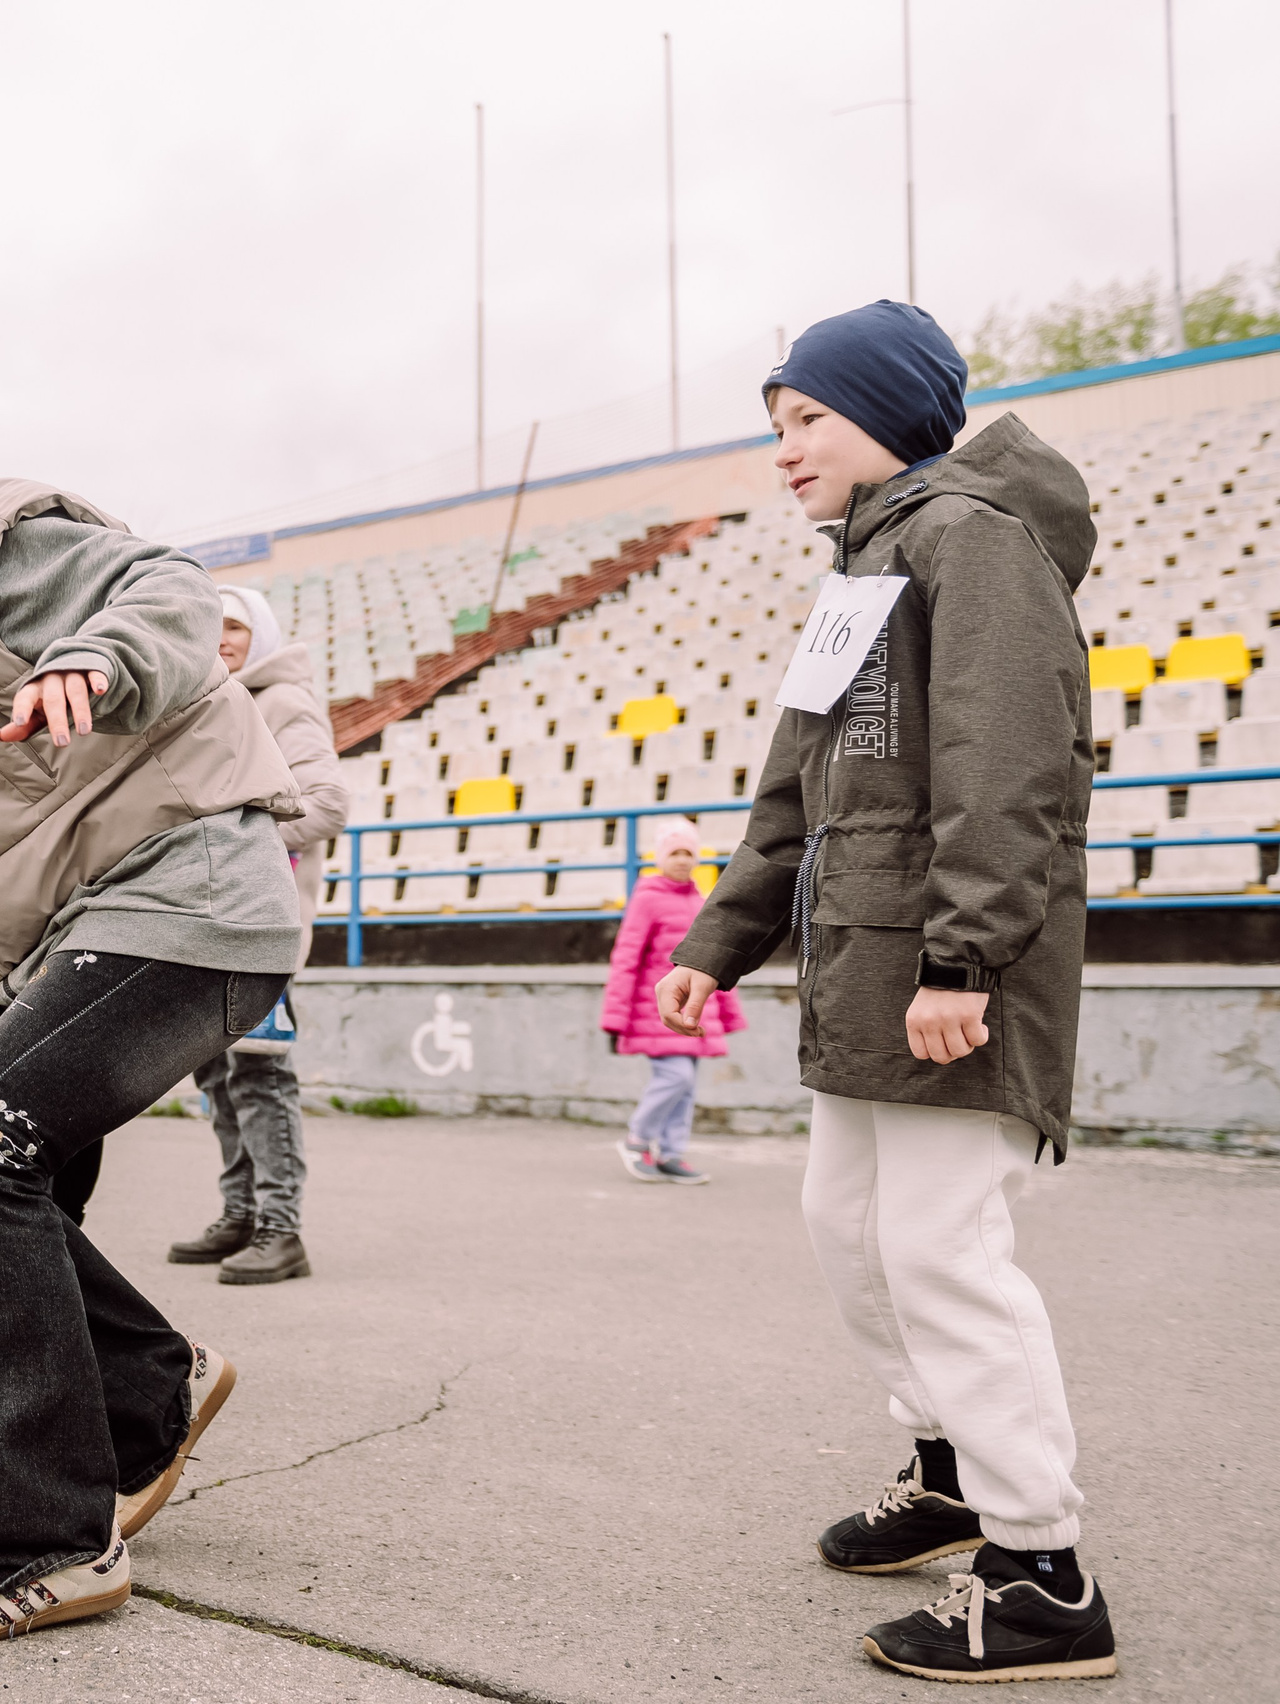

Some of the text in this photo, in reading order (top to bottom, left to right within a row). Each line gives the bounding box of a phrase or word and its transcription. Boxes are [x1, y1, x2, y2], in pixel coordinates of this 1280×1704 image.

[807, 610, 863, 656] 116
[844, 619, 888, 759] AT YOU GET
[890, 682, 899, 697] YOU
[890, 698, 899, 717] MAKE
[889, 725, 898, 747] LIVING
[889, 748, 898, 758] BY
